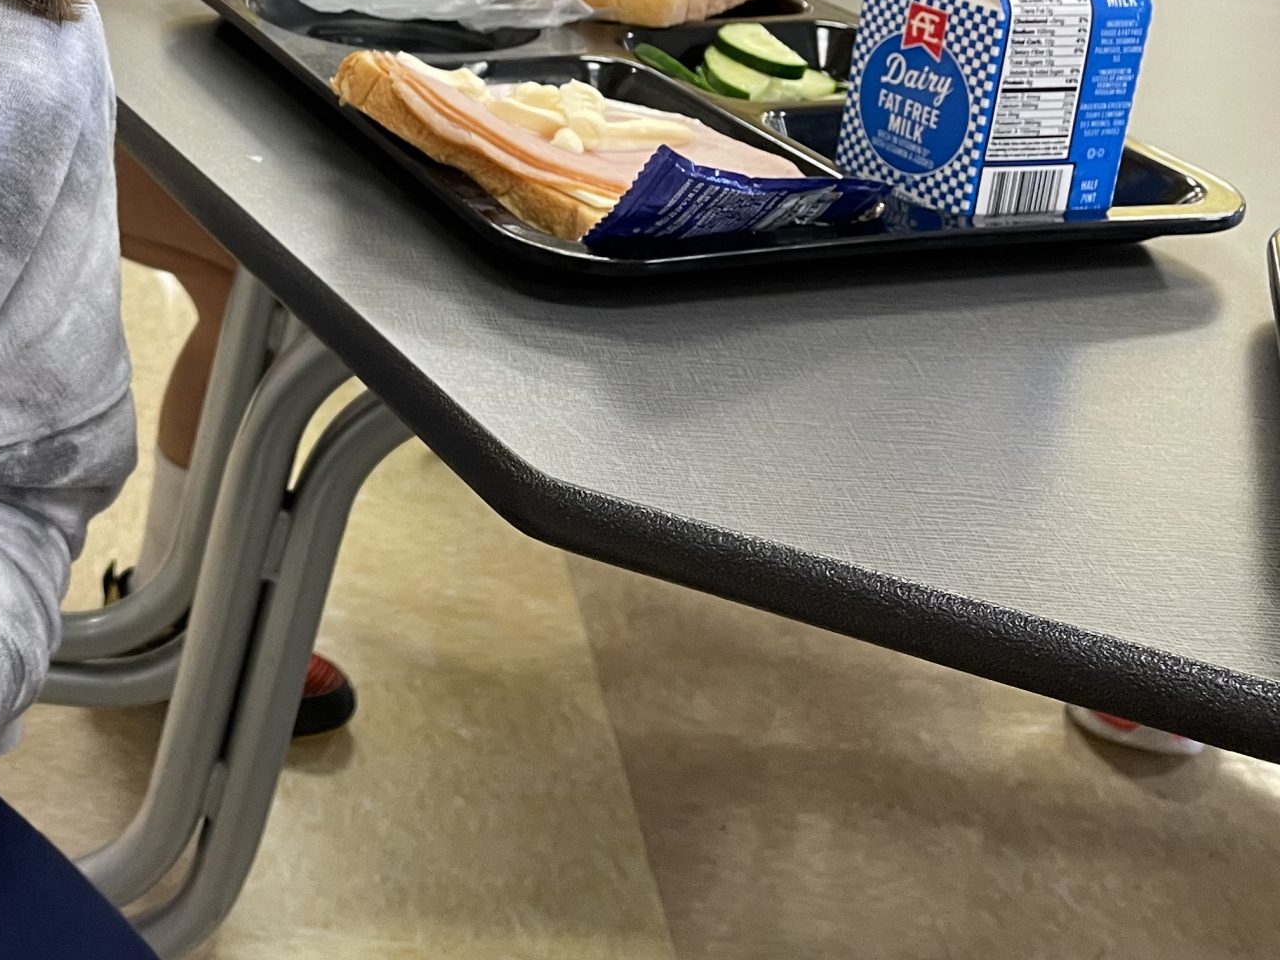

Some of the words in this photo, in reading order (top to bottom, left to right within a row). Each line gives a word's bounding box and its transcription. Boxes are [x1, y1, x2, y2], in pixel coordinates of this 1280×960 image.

[880, 52, 954, 107] Dairy
[878, 88, 904, 114] FAT
[904, 99, 940, 129] FREE
[888, 113, 924, 145] MILK
[1080, 178, 1099, 191] HALF
